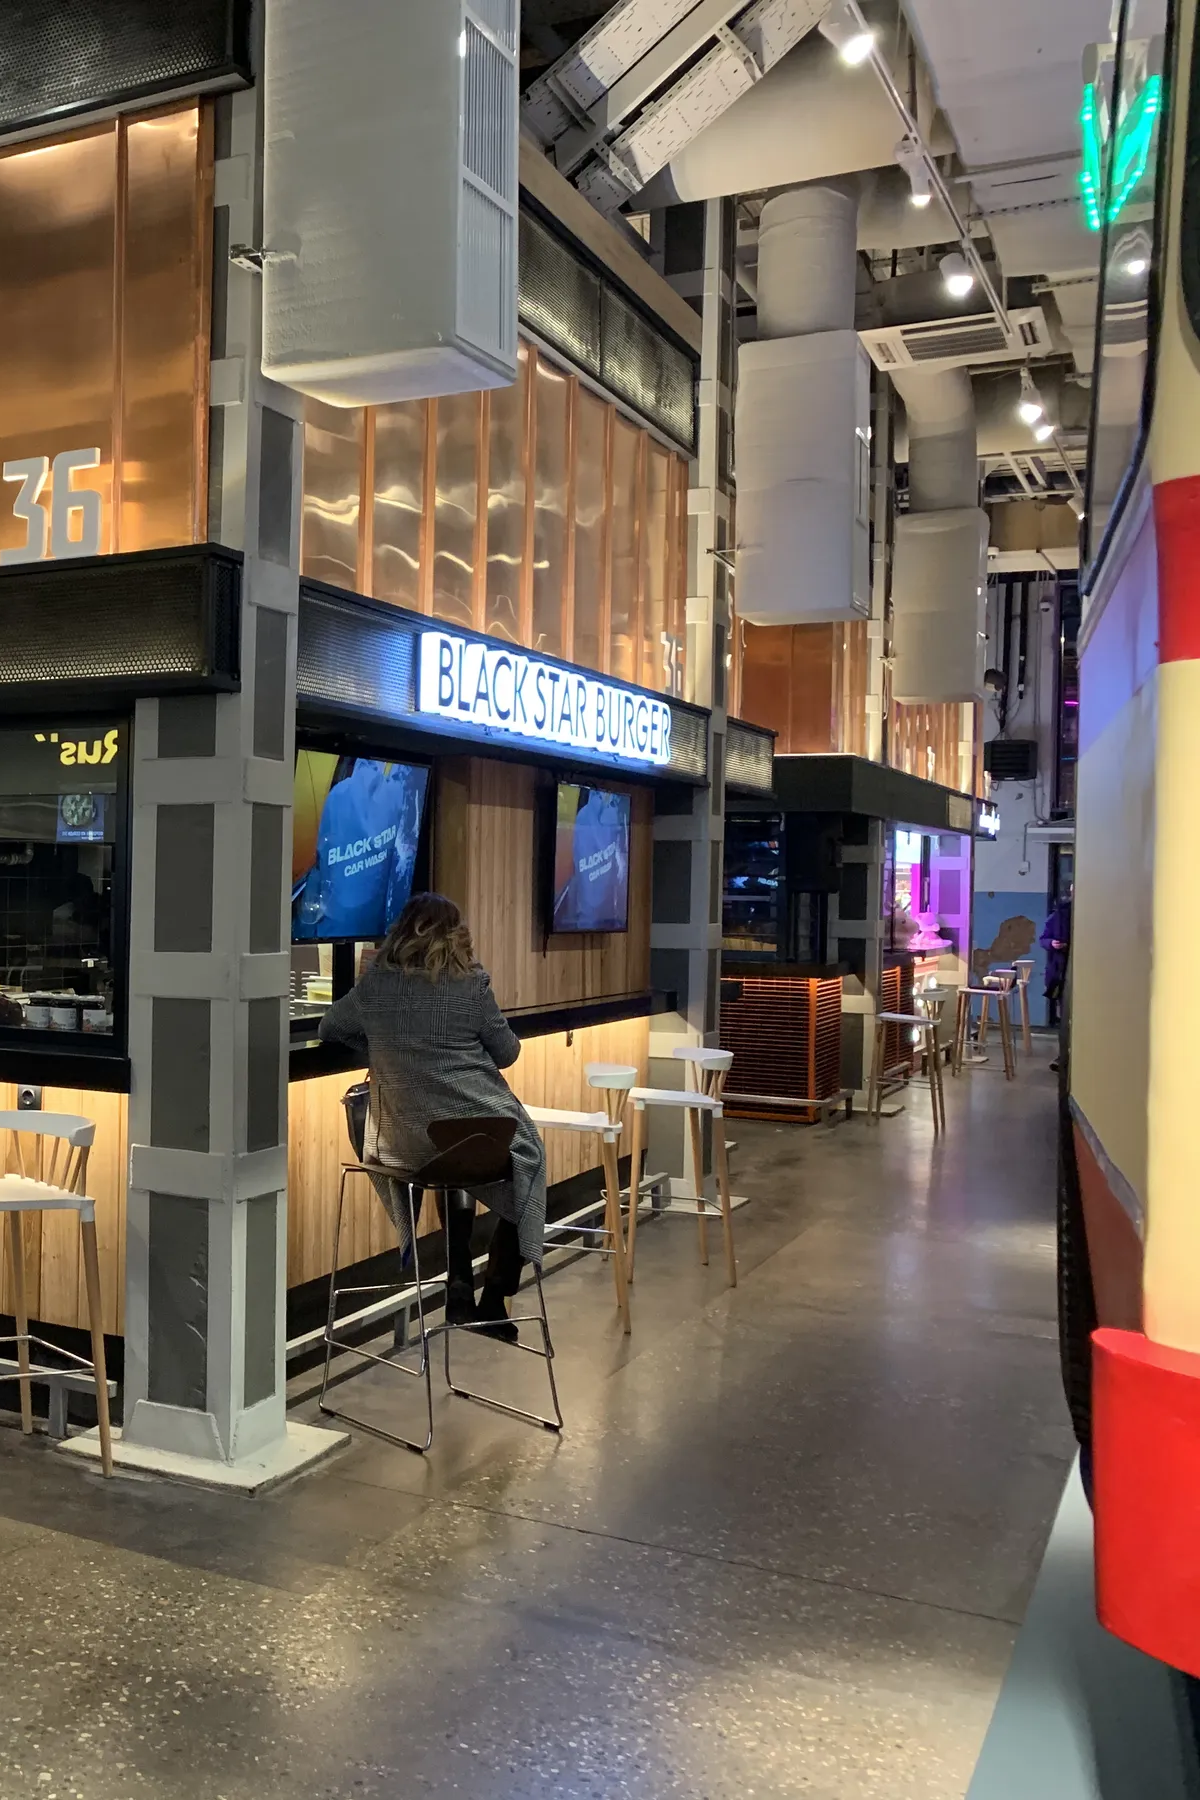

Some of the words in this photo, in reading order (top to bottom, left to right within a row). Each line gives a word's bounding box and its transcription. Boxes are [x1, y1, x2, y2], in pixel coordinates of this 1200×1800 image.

[0, 447, 102, 566] 36
[438, 638, 529, 725] BLACK
[533, 667, 588, 739] STAR
[595, 686, 673, 758] BURGER
[328, 837, 372, 866] BLACK
[373, 825, 397, 848] STAR
[344, 860, 364, 876] CAR
[364, 849, 388, 868] WASH
